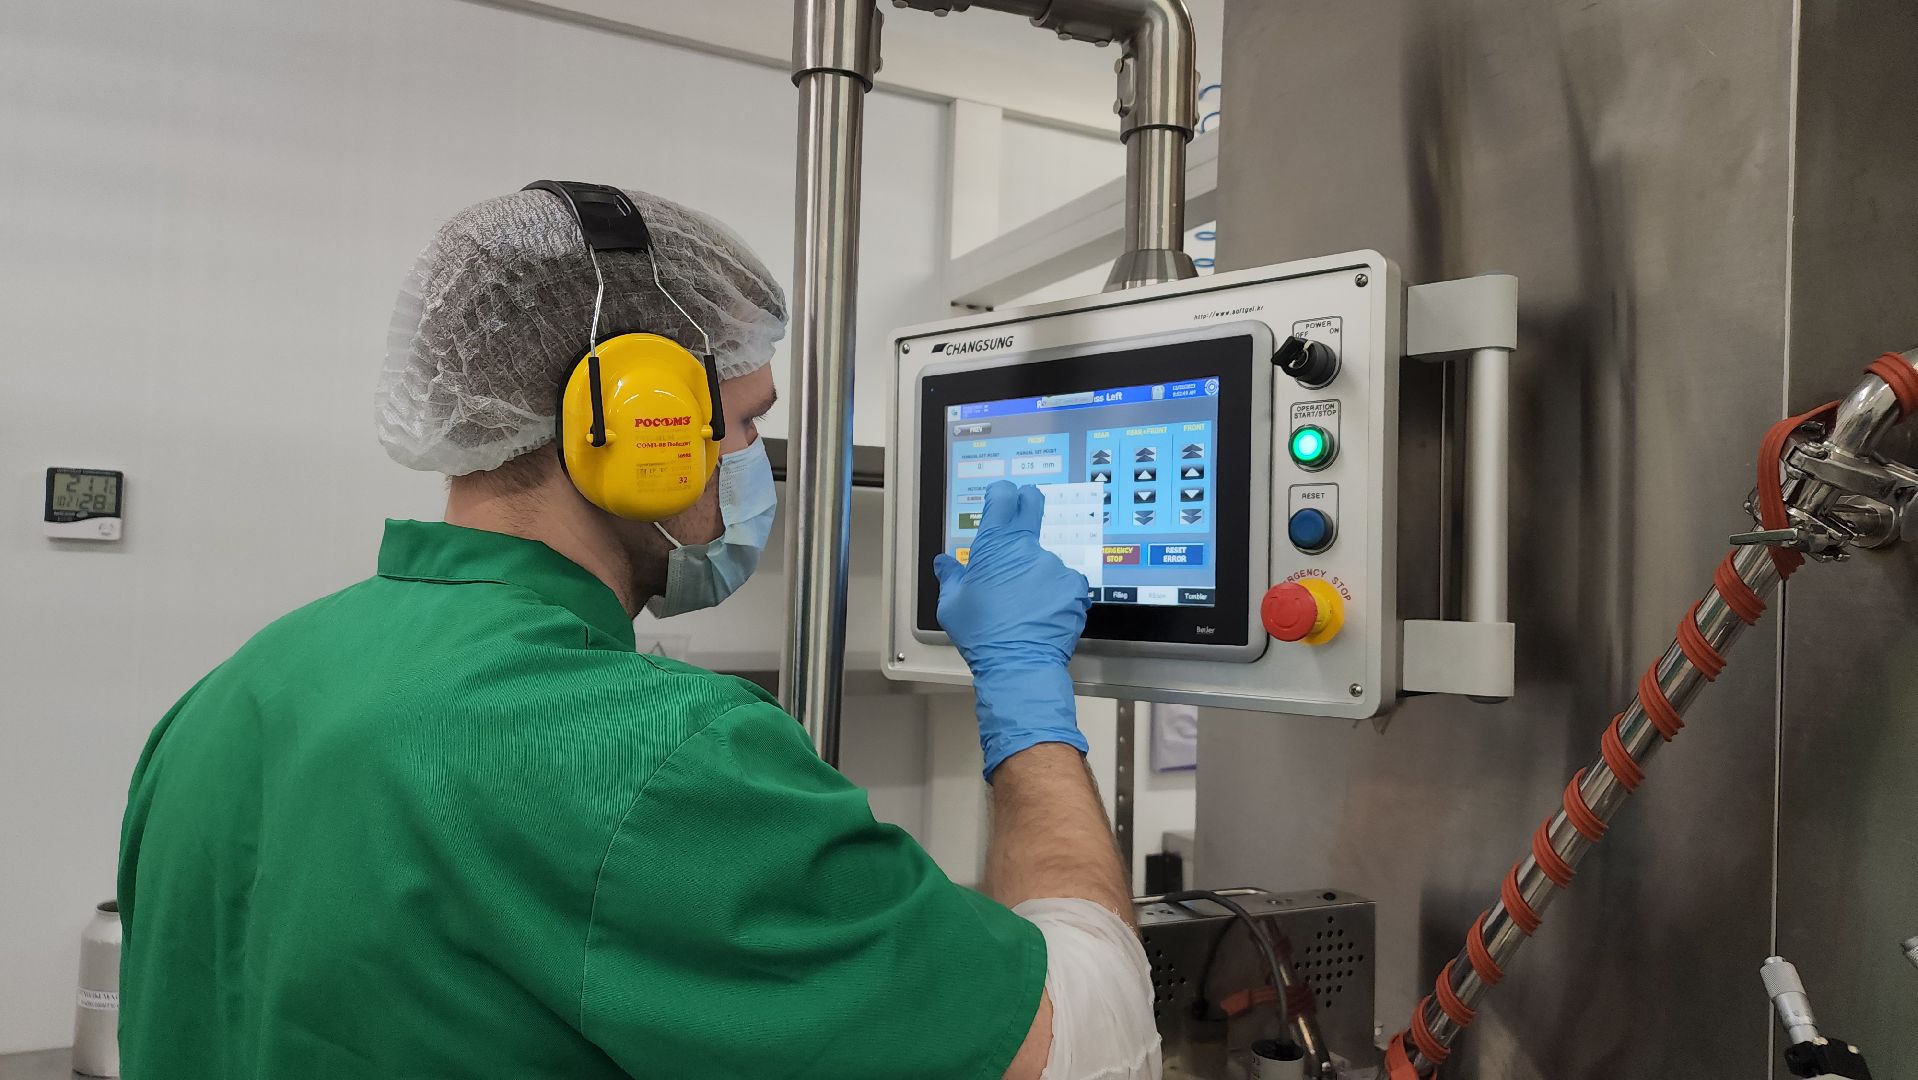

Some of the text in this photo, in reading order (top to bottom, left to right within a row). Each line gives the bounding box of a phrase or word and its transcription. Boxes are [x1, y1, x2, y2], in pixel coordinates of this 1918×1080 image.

[1306, 321, 1331, 329] POWER
[1295, 331, 1308, 339] OFF
[945, 336, 1014, 356] CHANGSUNG
[1106, 392, 1122, 401] Left
[1297, 404, 1334, 412] OPERATION
[1294, 410, 1336, 419] START/STOP
[1183, 423, 1205, 432] FRONT
[679, 476, 688, 484] 32
[1301, 492, 1325, 500] RESET
[1165, 546, 1187, 554] RESET
[1106, 554, 1123, 563] STOP
[1162, 554, 1187, 563] ERROR
[1331, 576, 1352, 601] STOP
